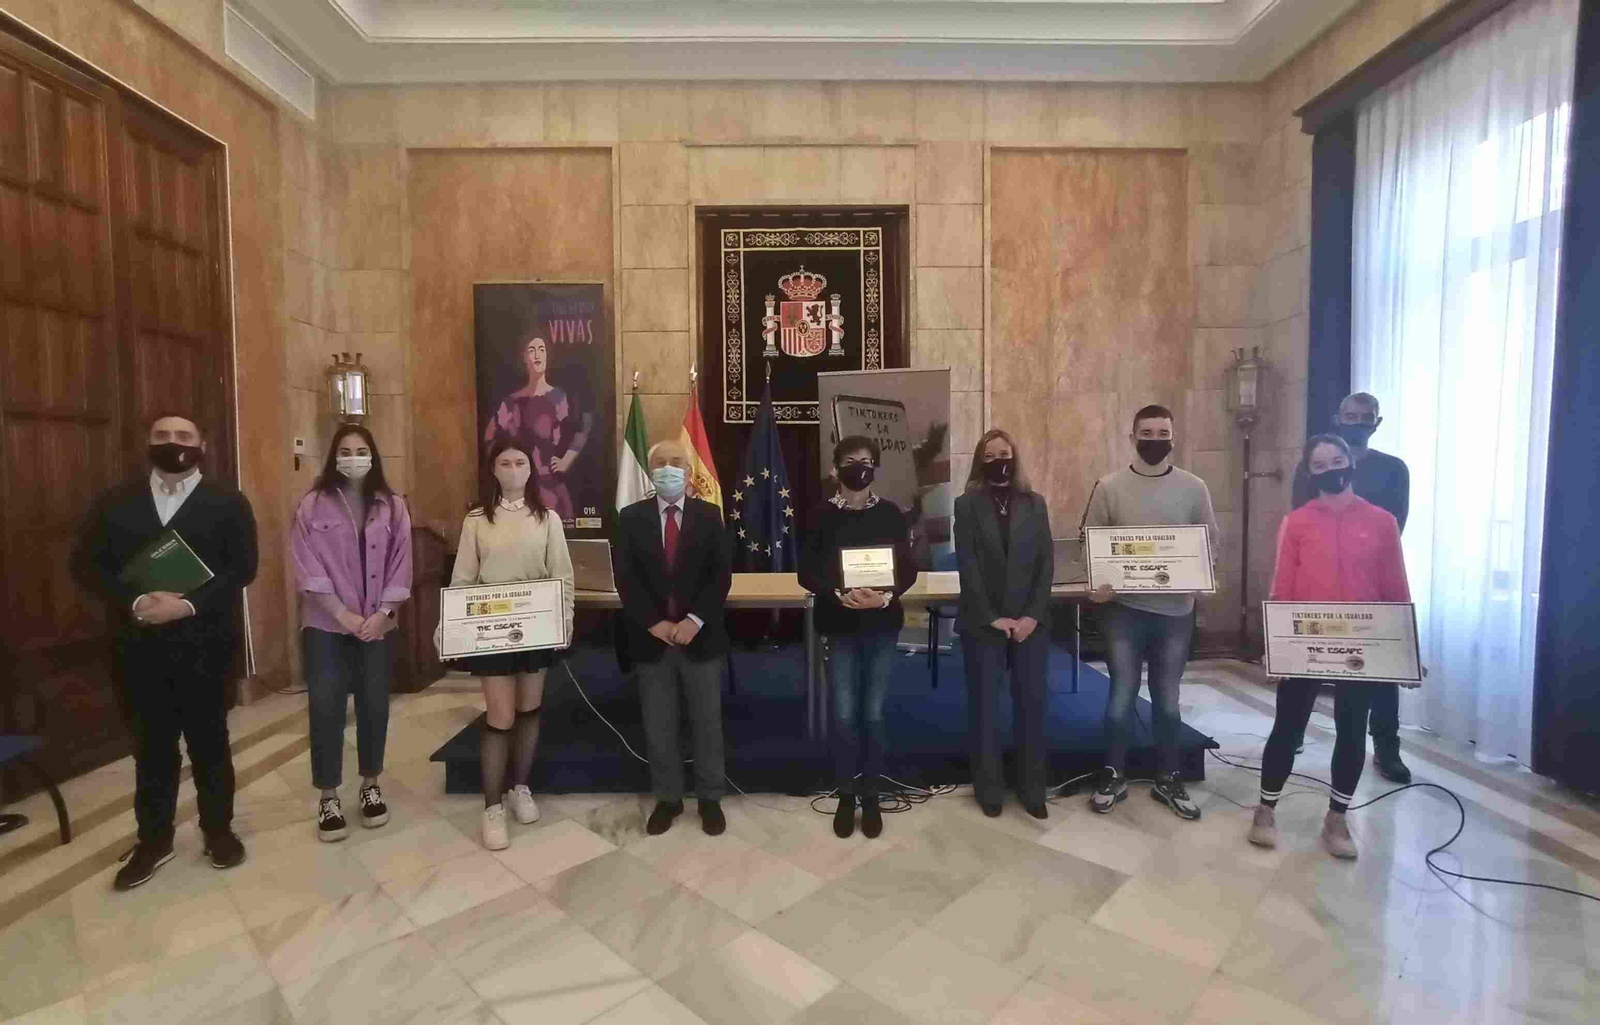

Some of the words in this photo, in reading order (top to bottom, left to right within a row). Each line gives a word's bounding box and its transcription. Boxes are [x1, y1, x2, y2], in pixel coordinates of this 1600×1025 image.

[549, 319, 593, 344] VIVAS
[877, 423, 889, 435] LA
[583, 506, 597, 516] 016
